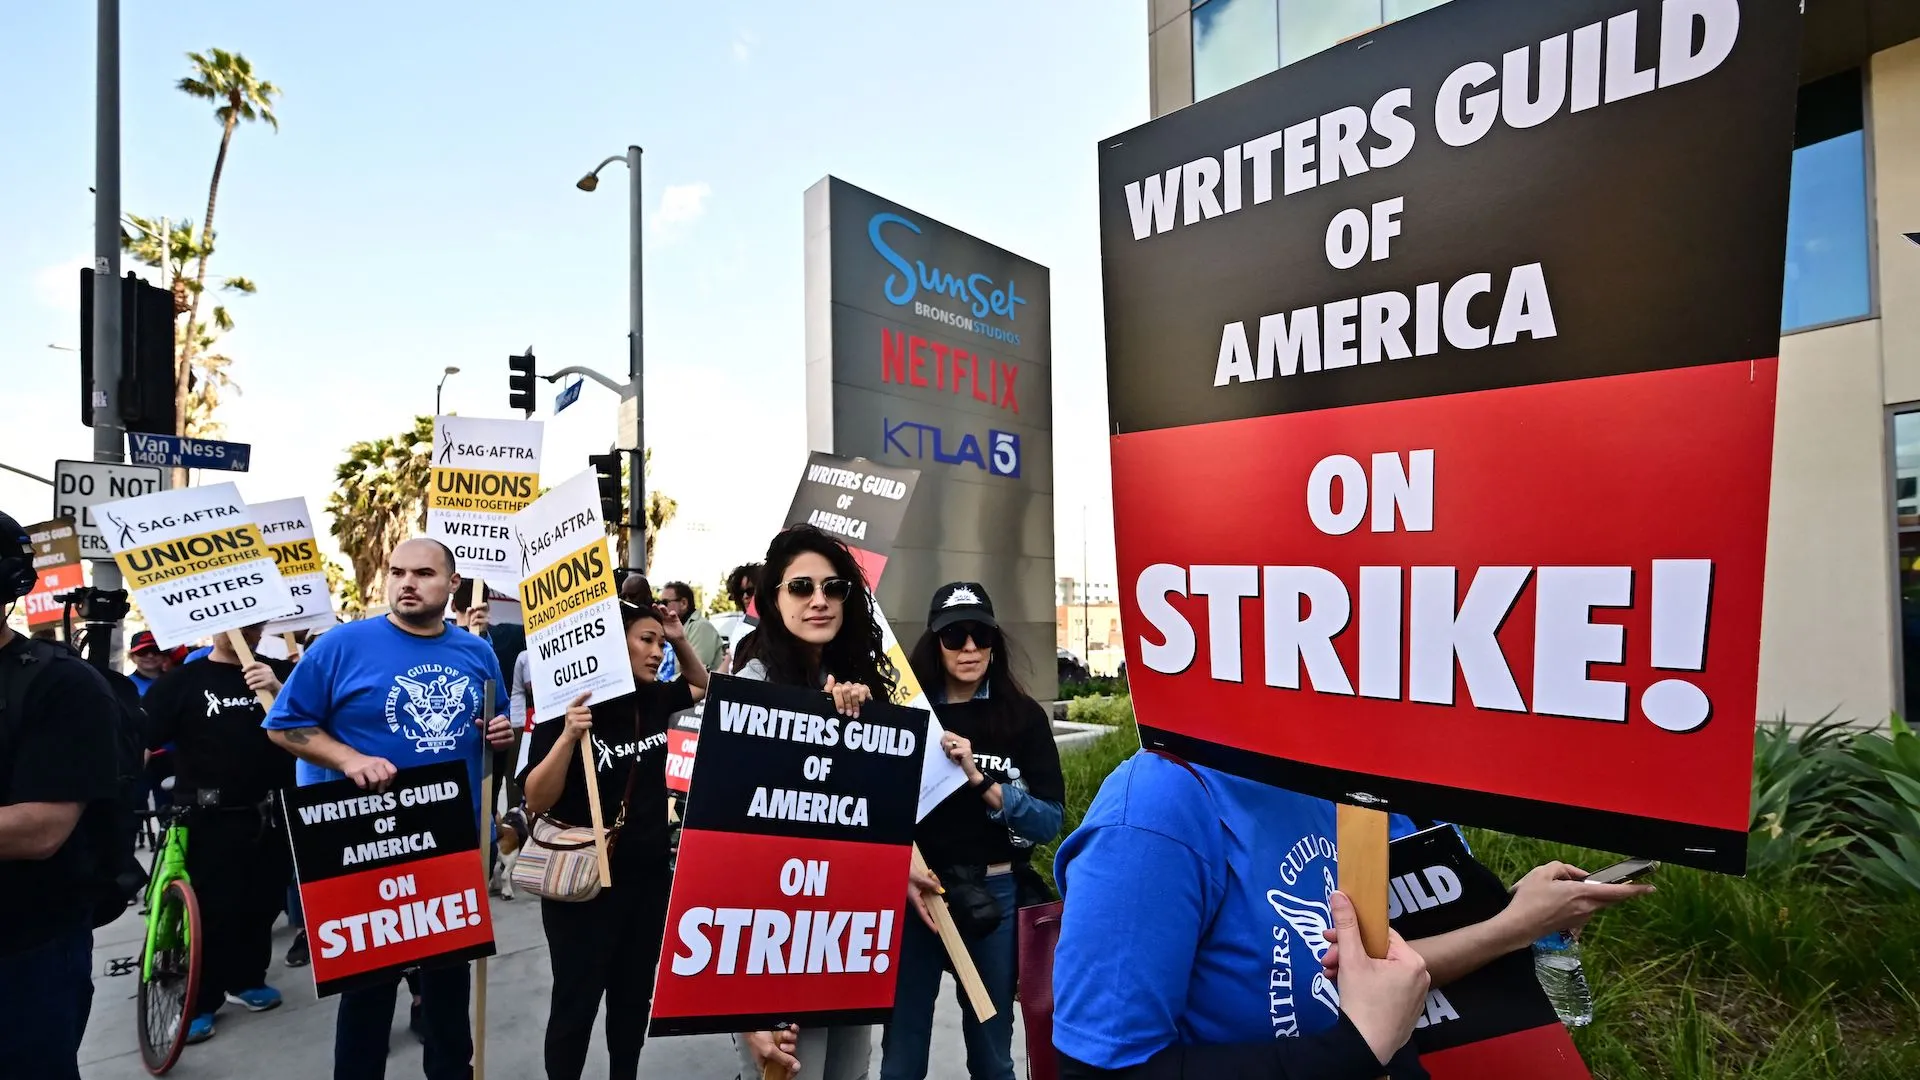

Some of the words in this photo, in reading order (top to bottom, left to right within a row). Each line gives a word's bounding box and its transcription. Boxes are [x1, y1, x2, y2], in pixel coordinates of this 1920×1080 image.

[1124, 87, 1416, 241] WRITERS
[1434, 0, 1740, 148] GUILD
[1325, 197, 1404, 270] OF
[1212, 262, 1557, 387] AMERICA
[881, 327, 1020, 415] NETFLIX
[135, 434, 169, 453] Van
[180, 439, 225, 458] Ness
[135, 452, 167, 465] 1400
[172, 454, 182, 465] N
[884, 417, 987, 470] KTLA
[231, 459, 245, 471] Av
[807, 464, 863, 490] WRITERS
[862, 475, 907, 500] GUILD
[61, 473, 95, 496] DO
[110, 476, 156, 498] NOT
[436, 495, 473, 509] STAND
[437, 471, 532, 498] UNIONS
[836, 493, 854, 510] OF
[1306, 448, 1434, 536] ON
[444, 522, 510, 540] WRITER
[807, 509, 868, 540] AMERICA
[126, 528, 255, 572] UNIONS
[137, 565, 186, 585] STAND
[190, 549, 261, 573] TOGETHER
[268, 542, 312, 565] ONS
[455, 545, 507, 562] GUILD
[162, 573, 264, 607] WRITERS
[524, 546, 604, 611] UNIONS
[189, 596, 257, 622] GUILD
[528, 605, 556, 630] STAND
[556, 581, 608, 617] TOGETHER
[569, 601, 612, 626] SUPPORTS
[538, 617, 606, 661] WRITERS
[1135, 557, 1713, 733] STRIKE!
[407, 664, 442, 678] GUILD
[444, 666, 460, 677] OF
[553, 655, 598, 688] GUILD
[719, 699, 840, 747] WRITERS
[844, 720, 917, 757] GUILD
[803, 755, 833, 782] OF
[298, 791, 397, 826] WRITERS
[399, 781, 460, 807] GUILD
[747, 786, 869, 827] AMERICA
[374, 816, 397, 834] OF
[342, 831, 437, 867] AMERICA
[379, 873, 417, 901] ON
[779, 857, 830, 897] ON
[1389, 865, 1463, 920] UILD
[318, 888, 482, 960] STRIKE!
[671, 905, 895, 976] STRIKE!
[1269, 925, 1300, 1038] RITERS
